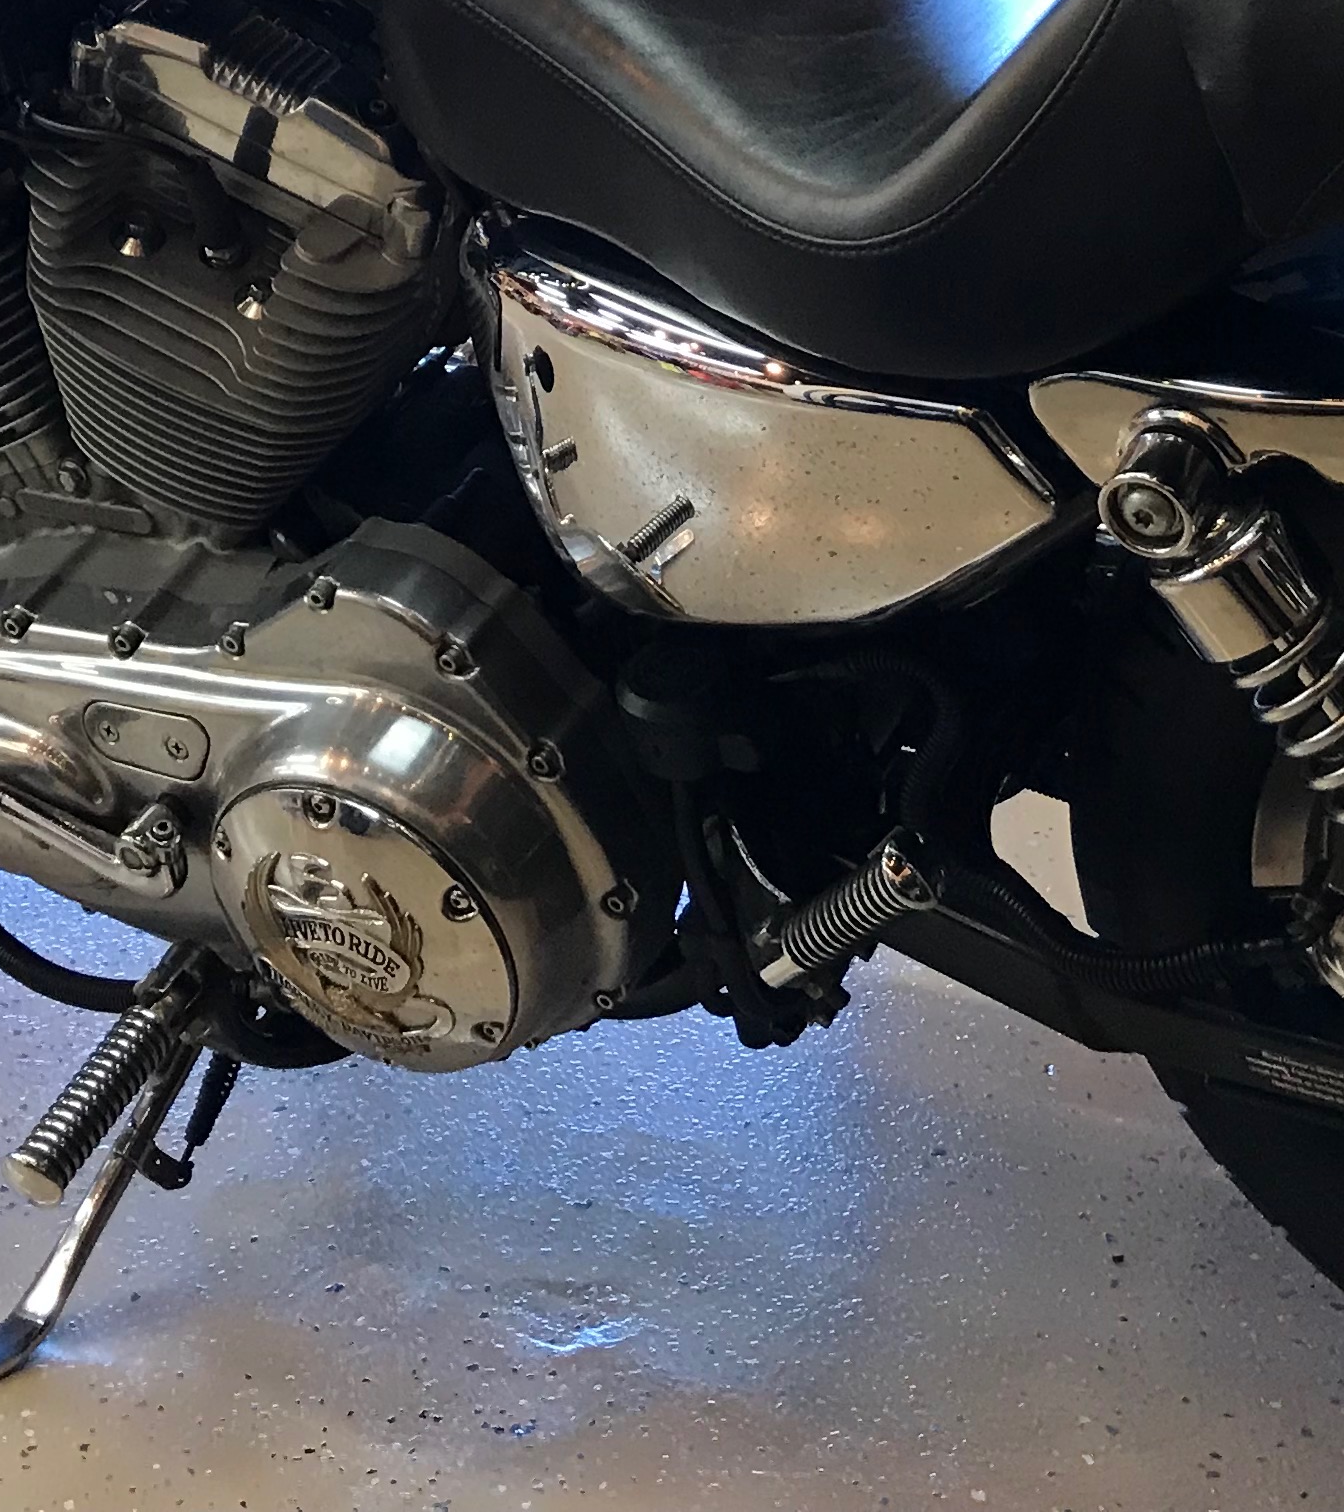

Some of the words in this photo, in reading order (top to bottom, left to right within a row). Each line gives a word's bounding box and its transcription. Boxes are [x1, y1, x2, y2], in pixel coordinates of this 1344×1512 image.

[319, 922, 346, 946] TO
[349, 932, 401, 979] RIDE
[361, 973, 390, 993] LIVE
